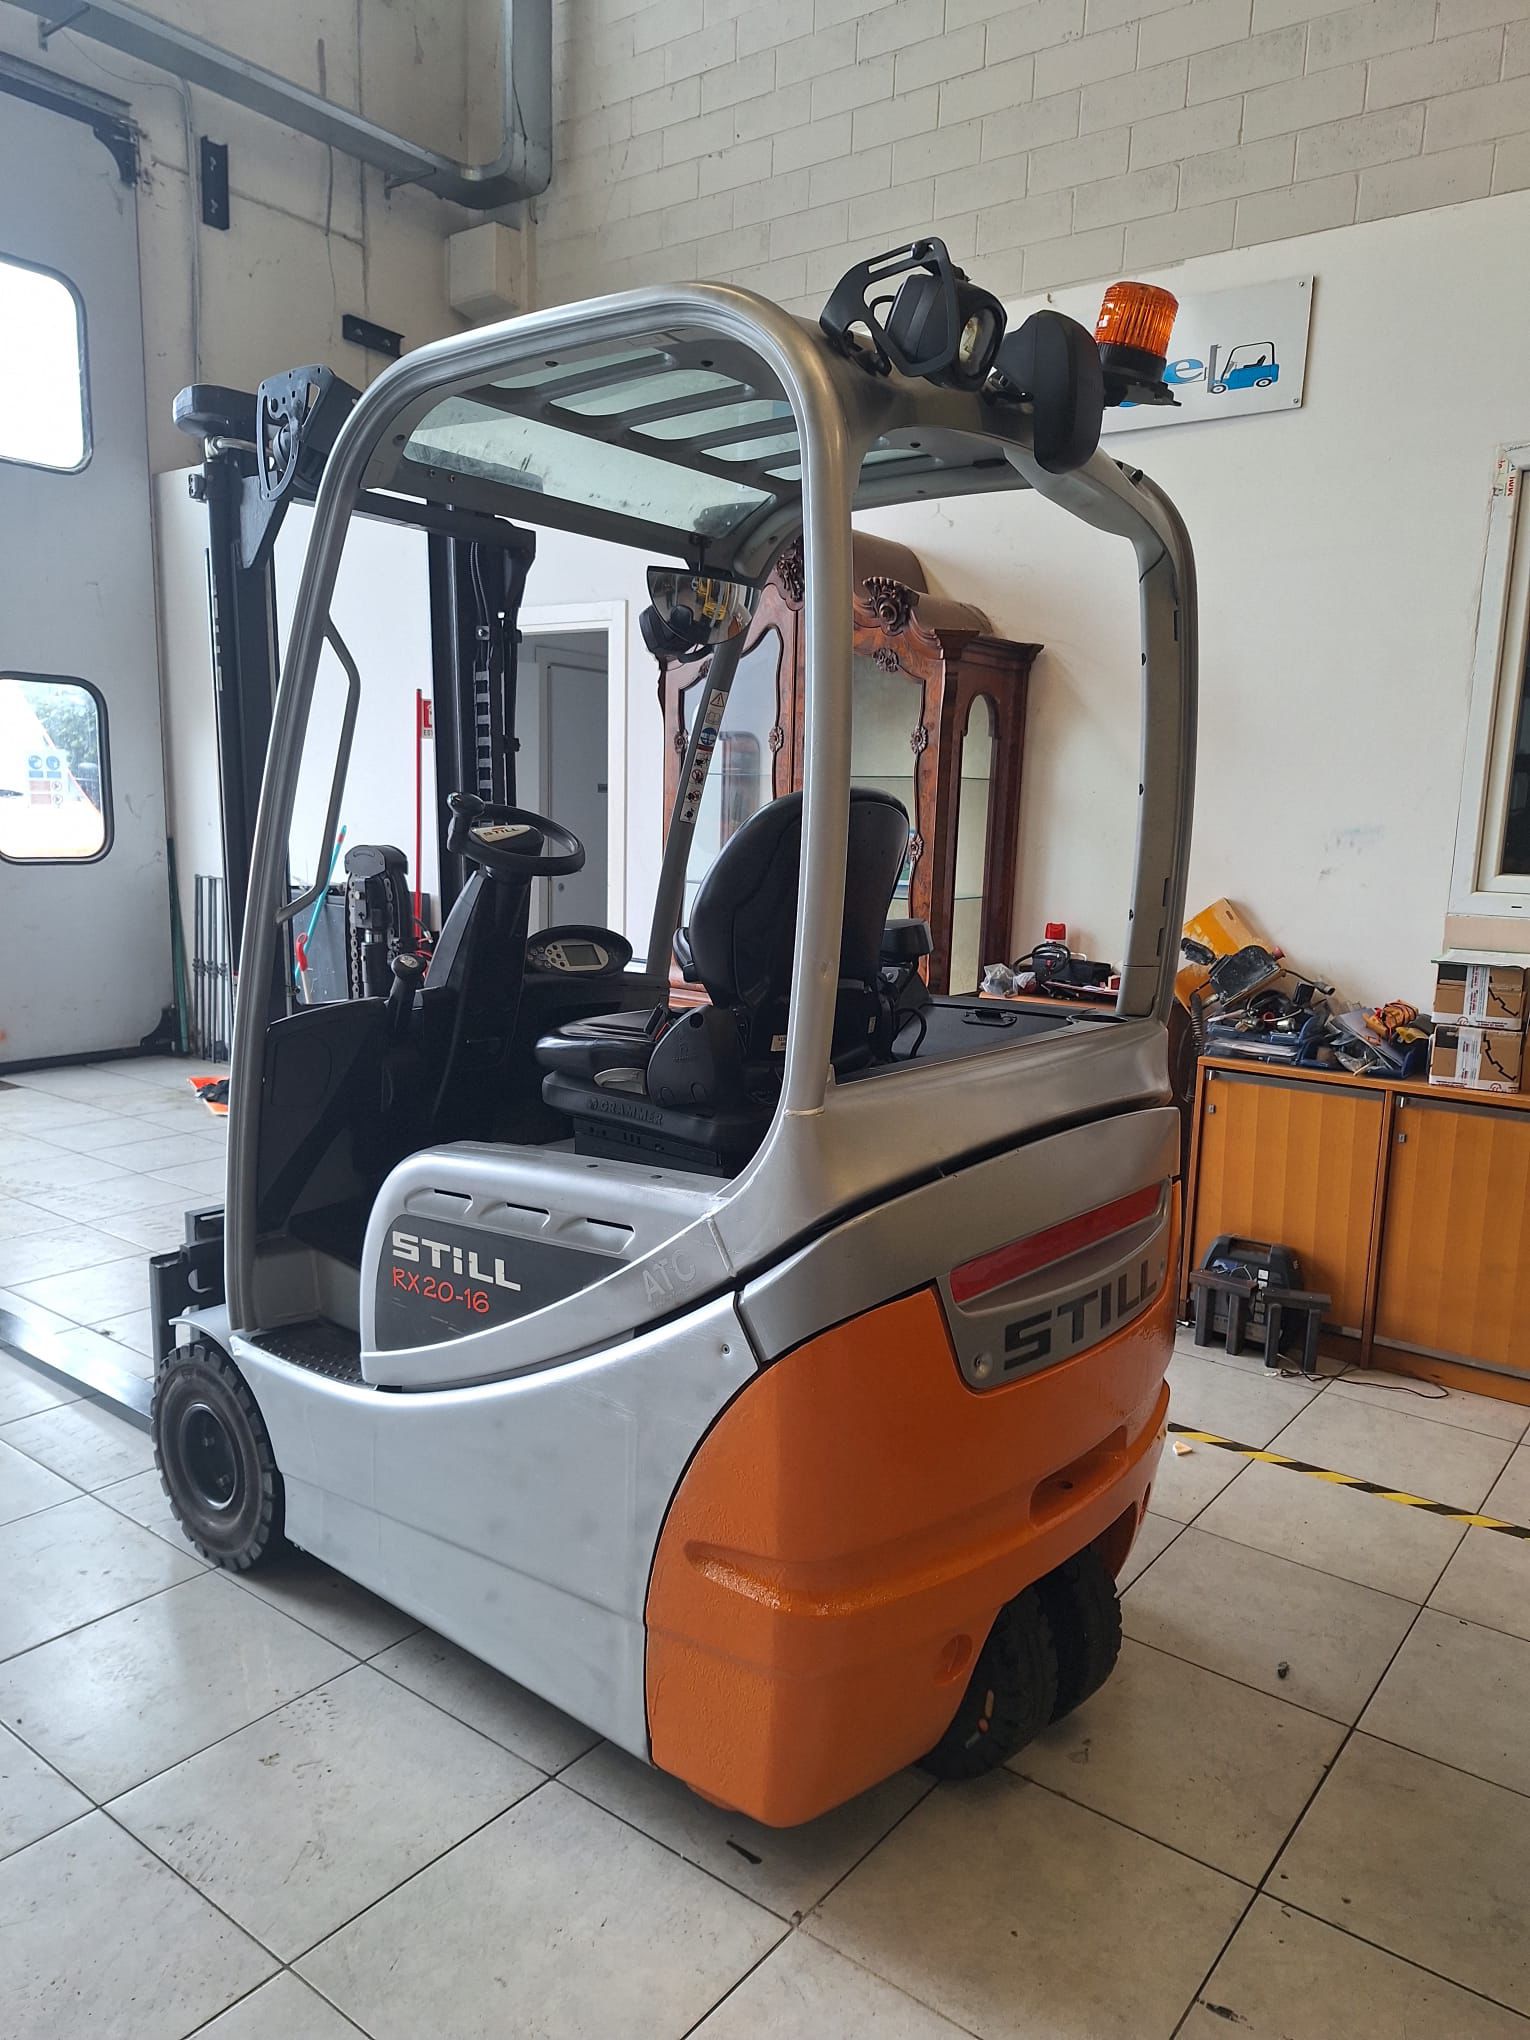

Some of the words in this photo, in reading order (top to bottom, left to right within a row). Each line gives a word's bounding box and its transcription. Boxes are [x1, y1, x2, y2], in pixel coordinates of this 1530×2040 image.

[600, 1101, 664, 1126] GRAMMER
[392, 1266, 490, 1313] RX20-16
[1003, 1259, 1158, 1371] STILL
